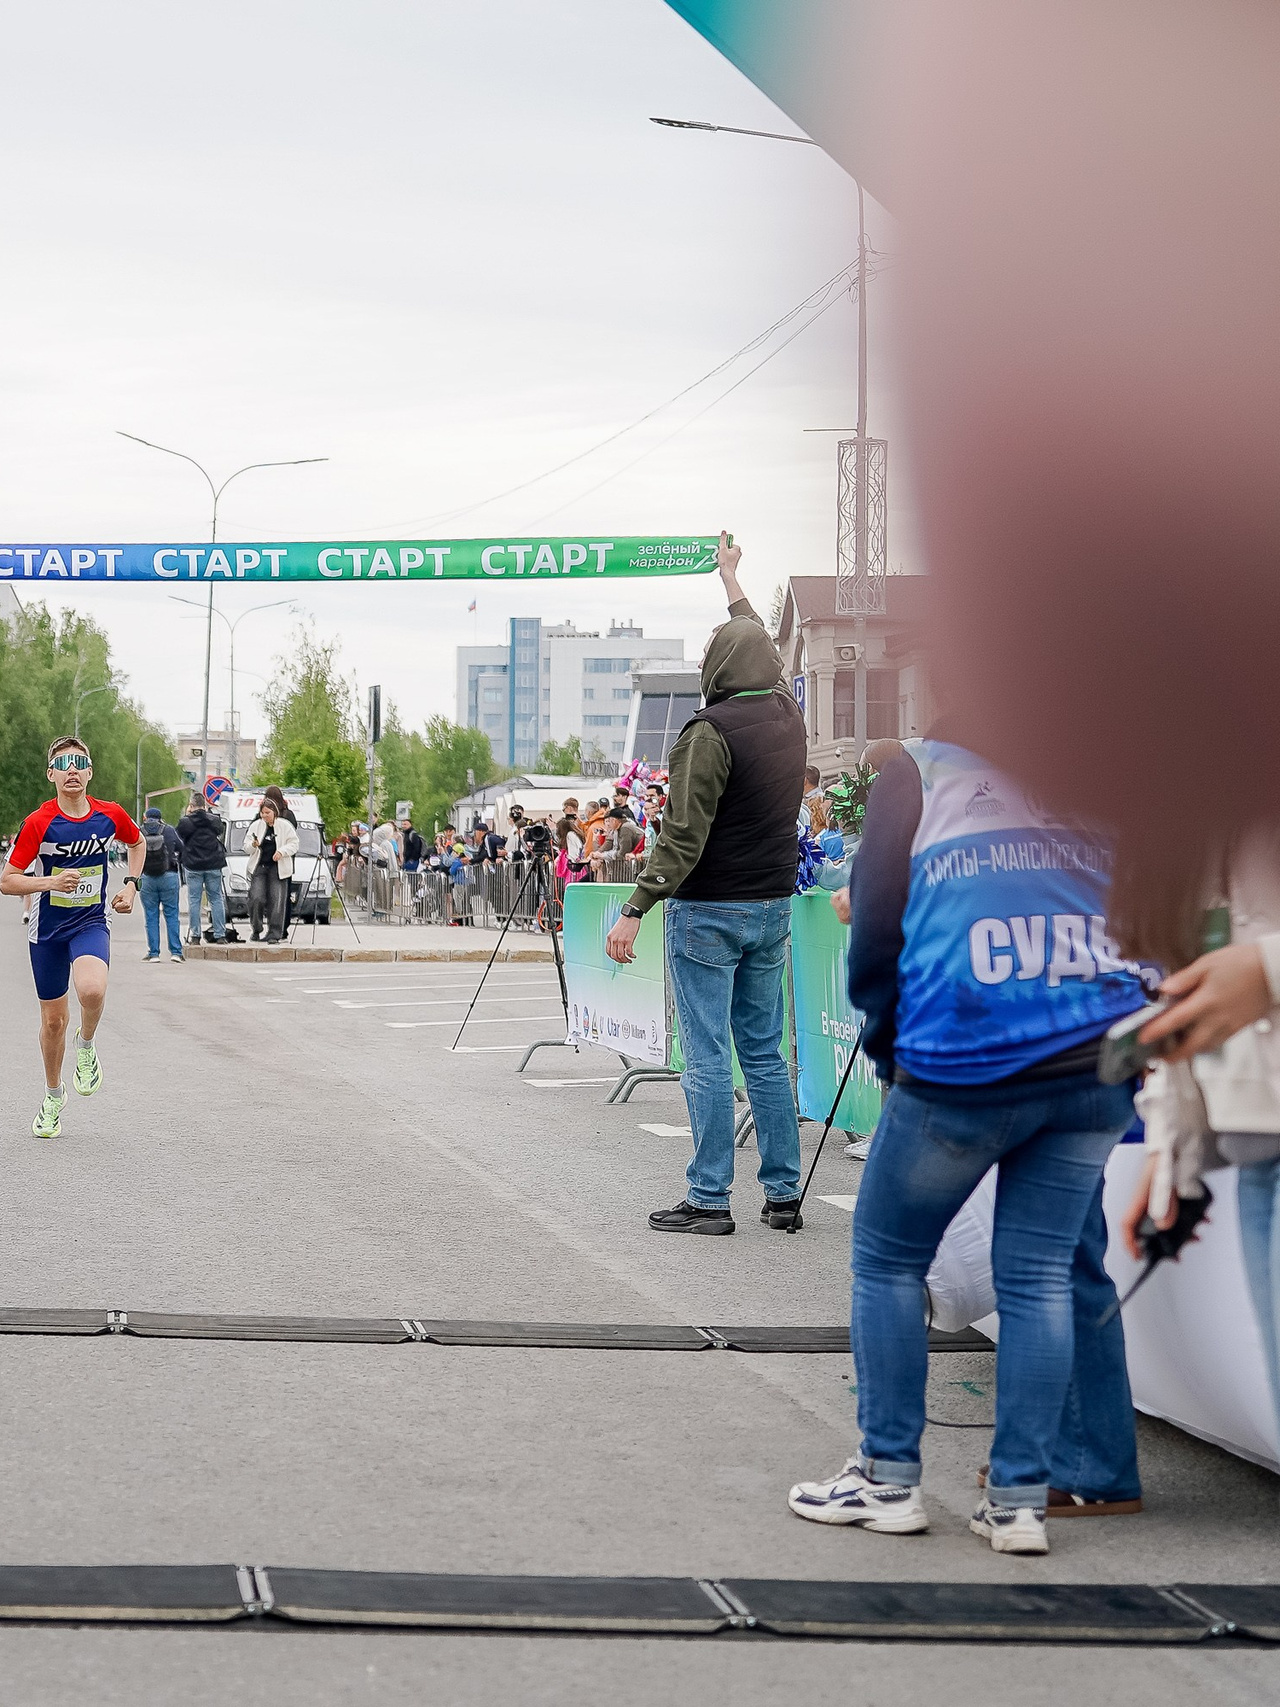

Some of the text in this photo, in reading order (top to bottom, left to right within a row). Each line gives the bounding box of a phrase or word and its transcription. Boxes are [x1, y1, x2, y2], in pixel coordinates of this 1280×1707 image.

[152, 547, 287, 578] СТАРТ
[317, 546, 451, 578] СТАРТ
[480, 543, 614, 576] СТАРТ
[629, 554, 694, 569] марафон
[637, 541, 701, 556] зелёный
[301, 821, 317, 830] 03
[970, 913, 1163, 988] СУДЬ
[821, 1010, 859, 1043] В твоём
[834, 1043, 883, 1092] ритм
